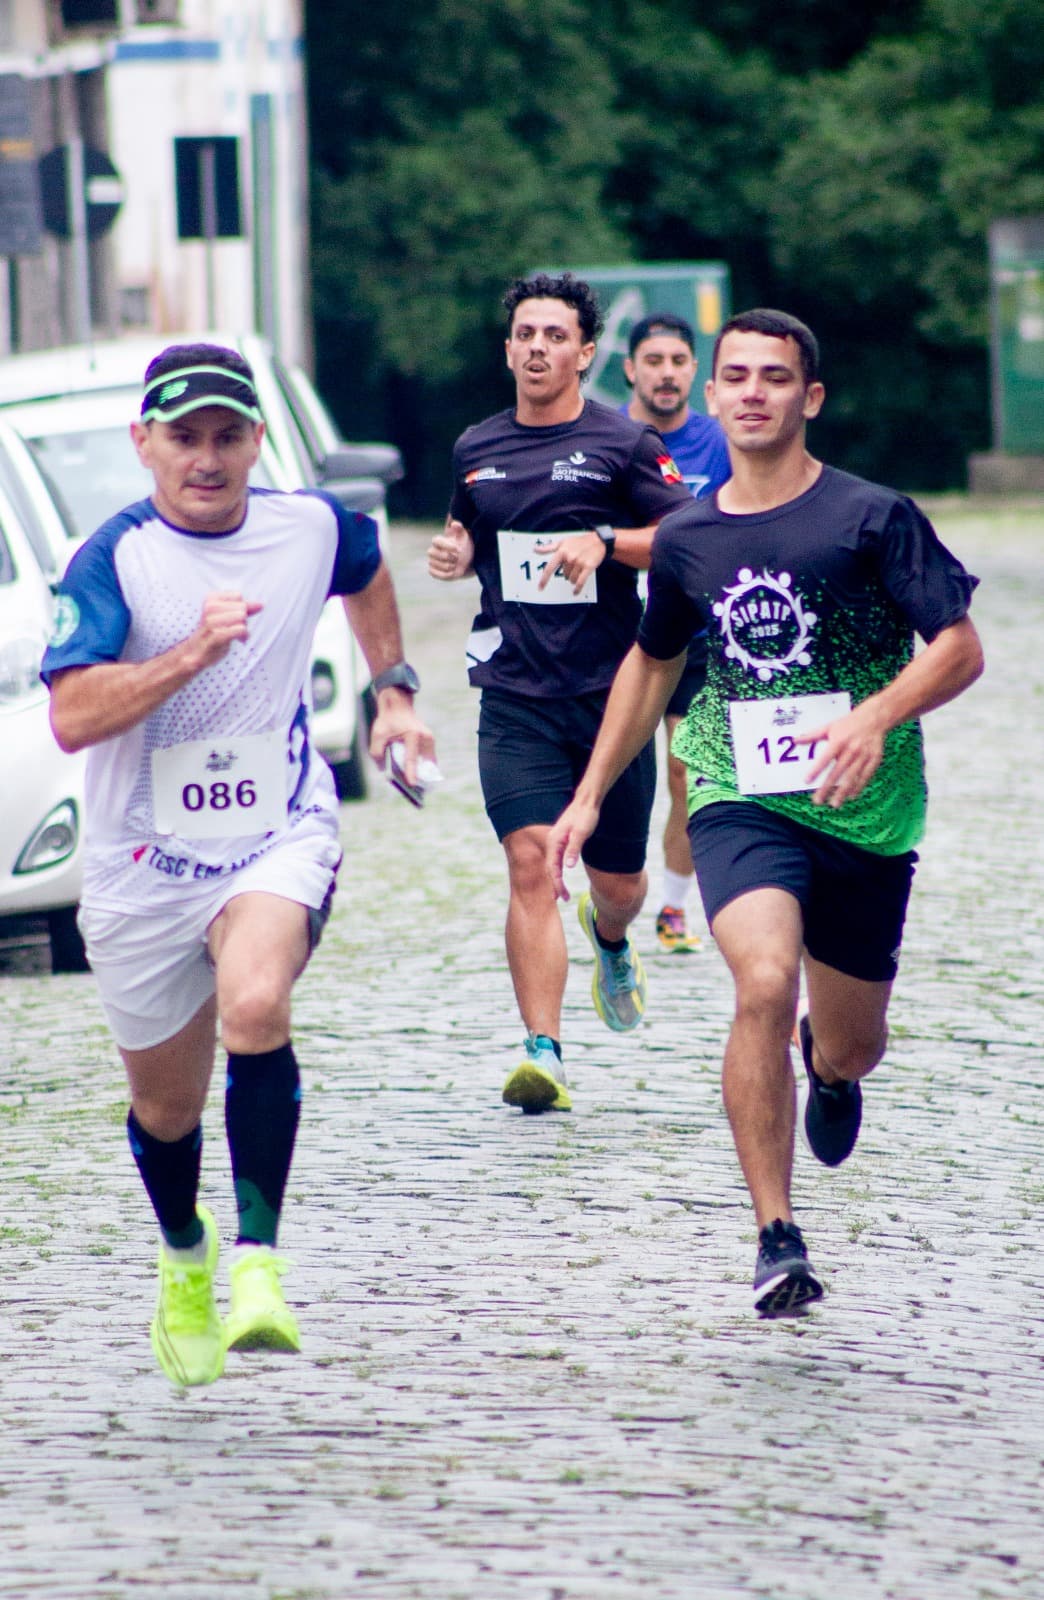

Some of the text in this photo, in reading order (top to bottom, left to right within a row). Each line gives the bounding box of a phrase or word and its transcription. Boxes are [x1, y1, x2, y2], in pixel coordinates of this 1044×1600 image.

[564, 474, 579, 482] SUL
[569, 469, 611, 482] FRANCISCO
[750, 624, 779, 638] 2025
[758, 736, 818, 764] 127
[182, 780, 257, 812] 086
[149, 846, 223, 879] TESC EM
